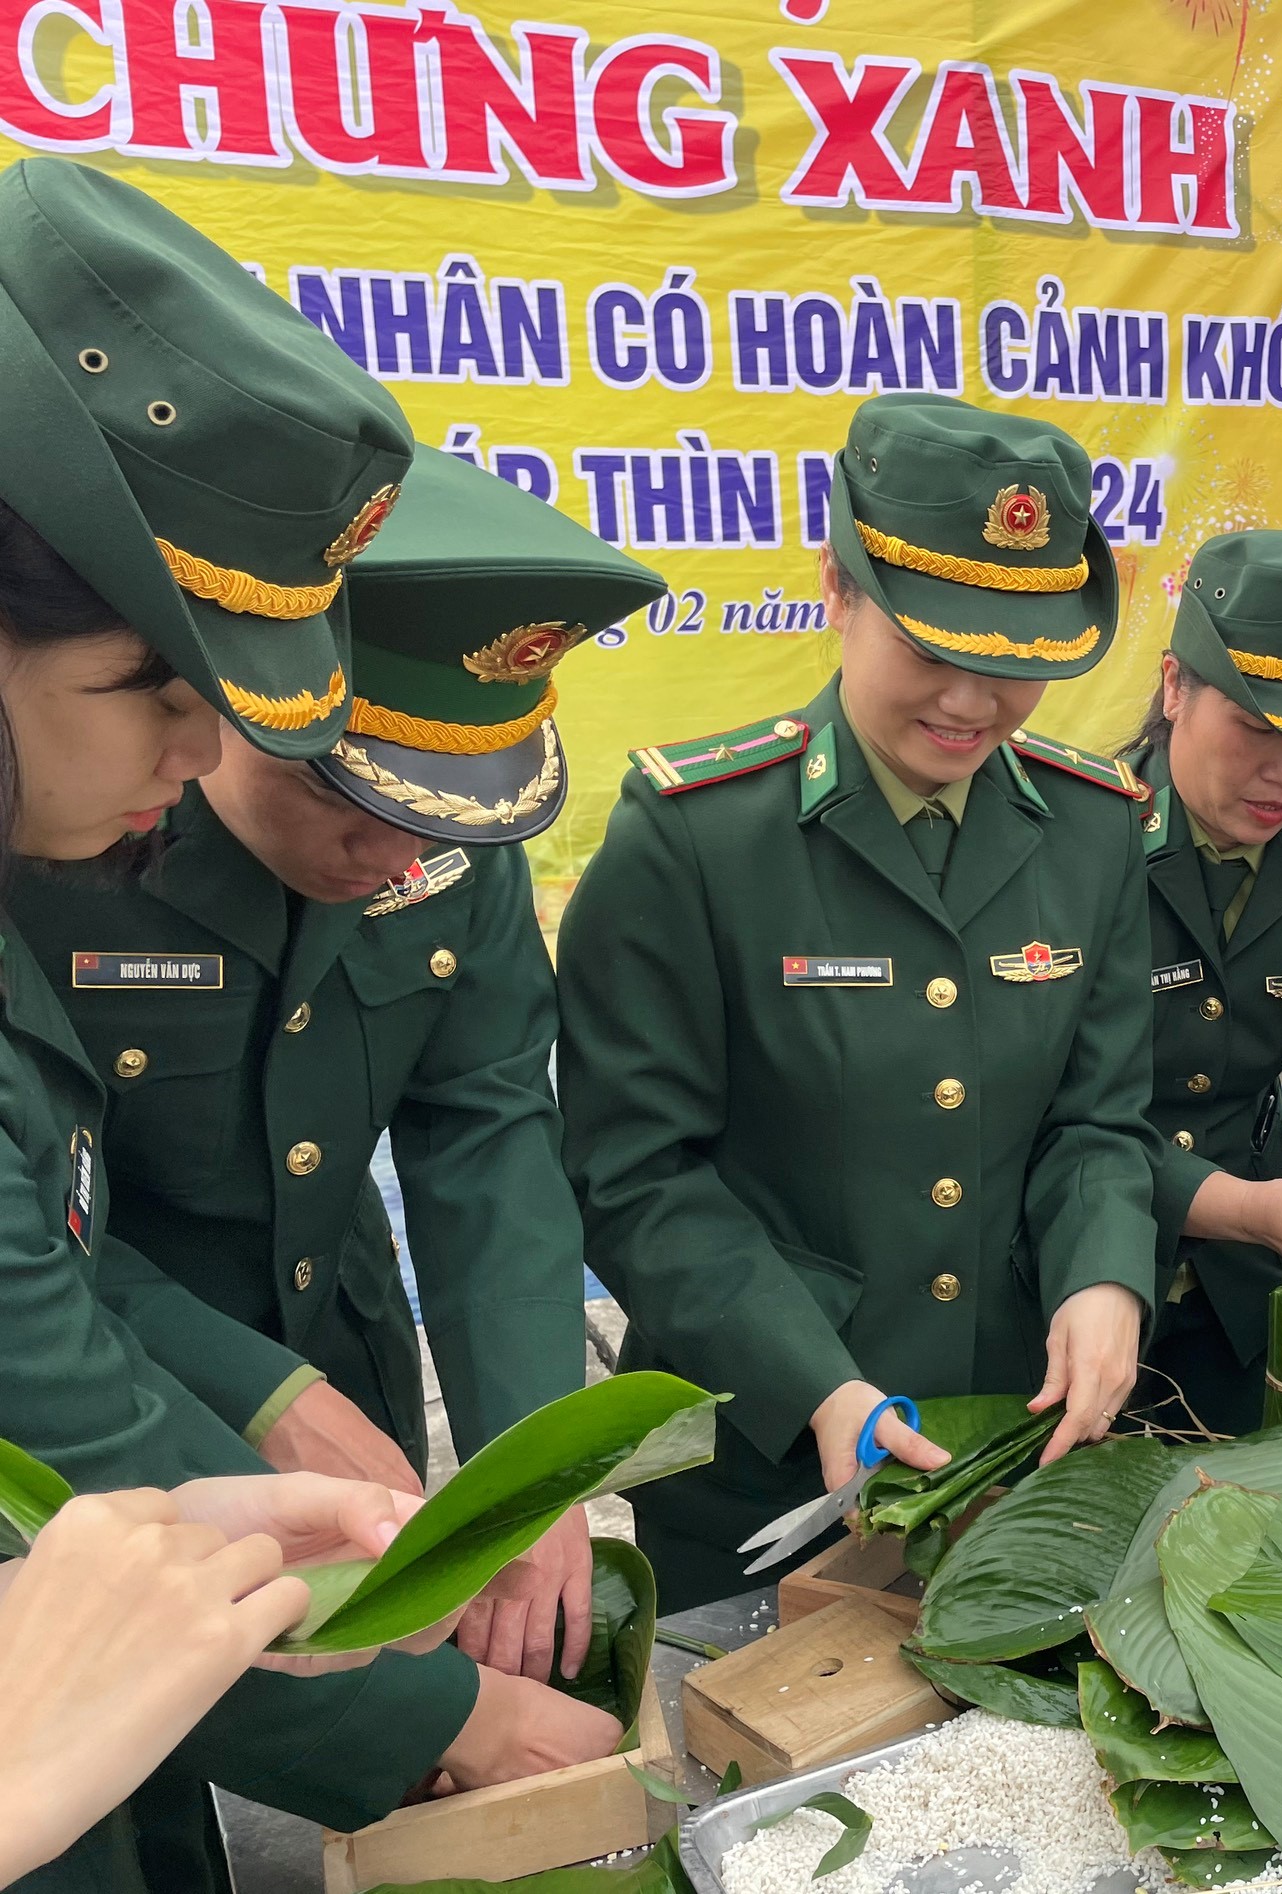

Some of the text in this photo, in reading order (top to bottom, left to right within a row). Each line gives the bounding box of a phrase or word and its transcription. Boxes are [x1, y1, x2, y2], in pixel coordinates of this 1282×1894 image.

[0, 0, 1236, 231] CHƯNG XANH
[295, 259, 565, 381] NHÂN
[592, 272, 707, 386] CÓ
[733, 280, 959, 391] HOÀN
[984, 278, 1166, 400] CẢNH
[578, 434, 777, 543] THÌN
[1090, 461, 1164, 541] 24
[649, 590, 704, 634] 02
[721, 588, 827, 632] năm
[120, 957, 158, 979] NGUYỄN
[160, 960, 180, 979] VĂN
[1160, 972, 1172, 985] THỊ
